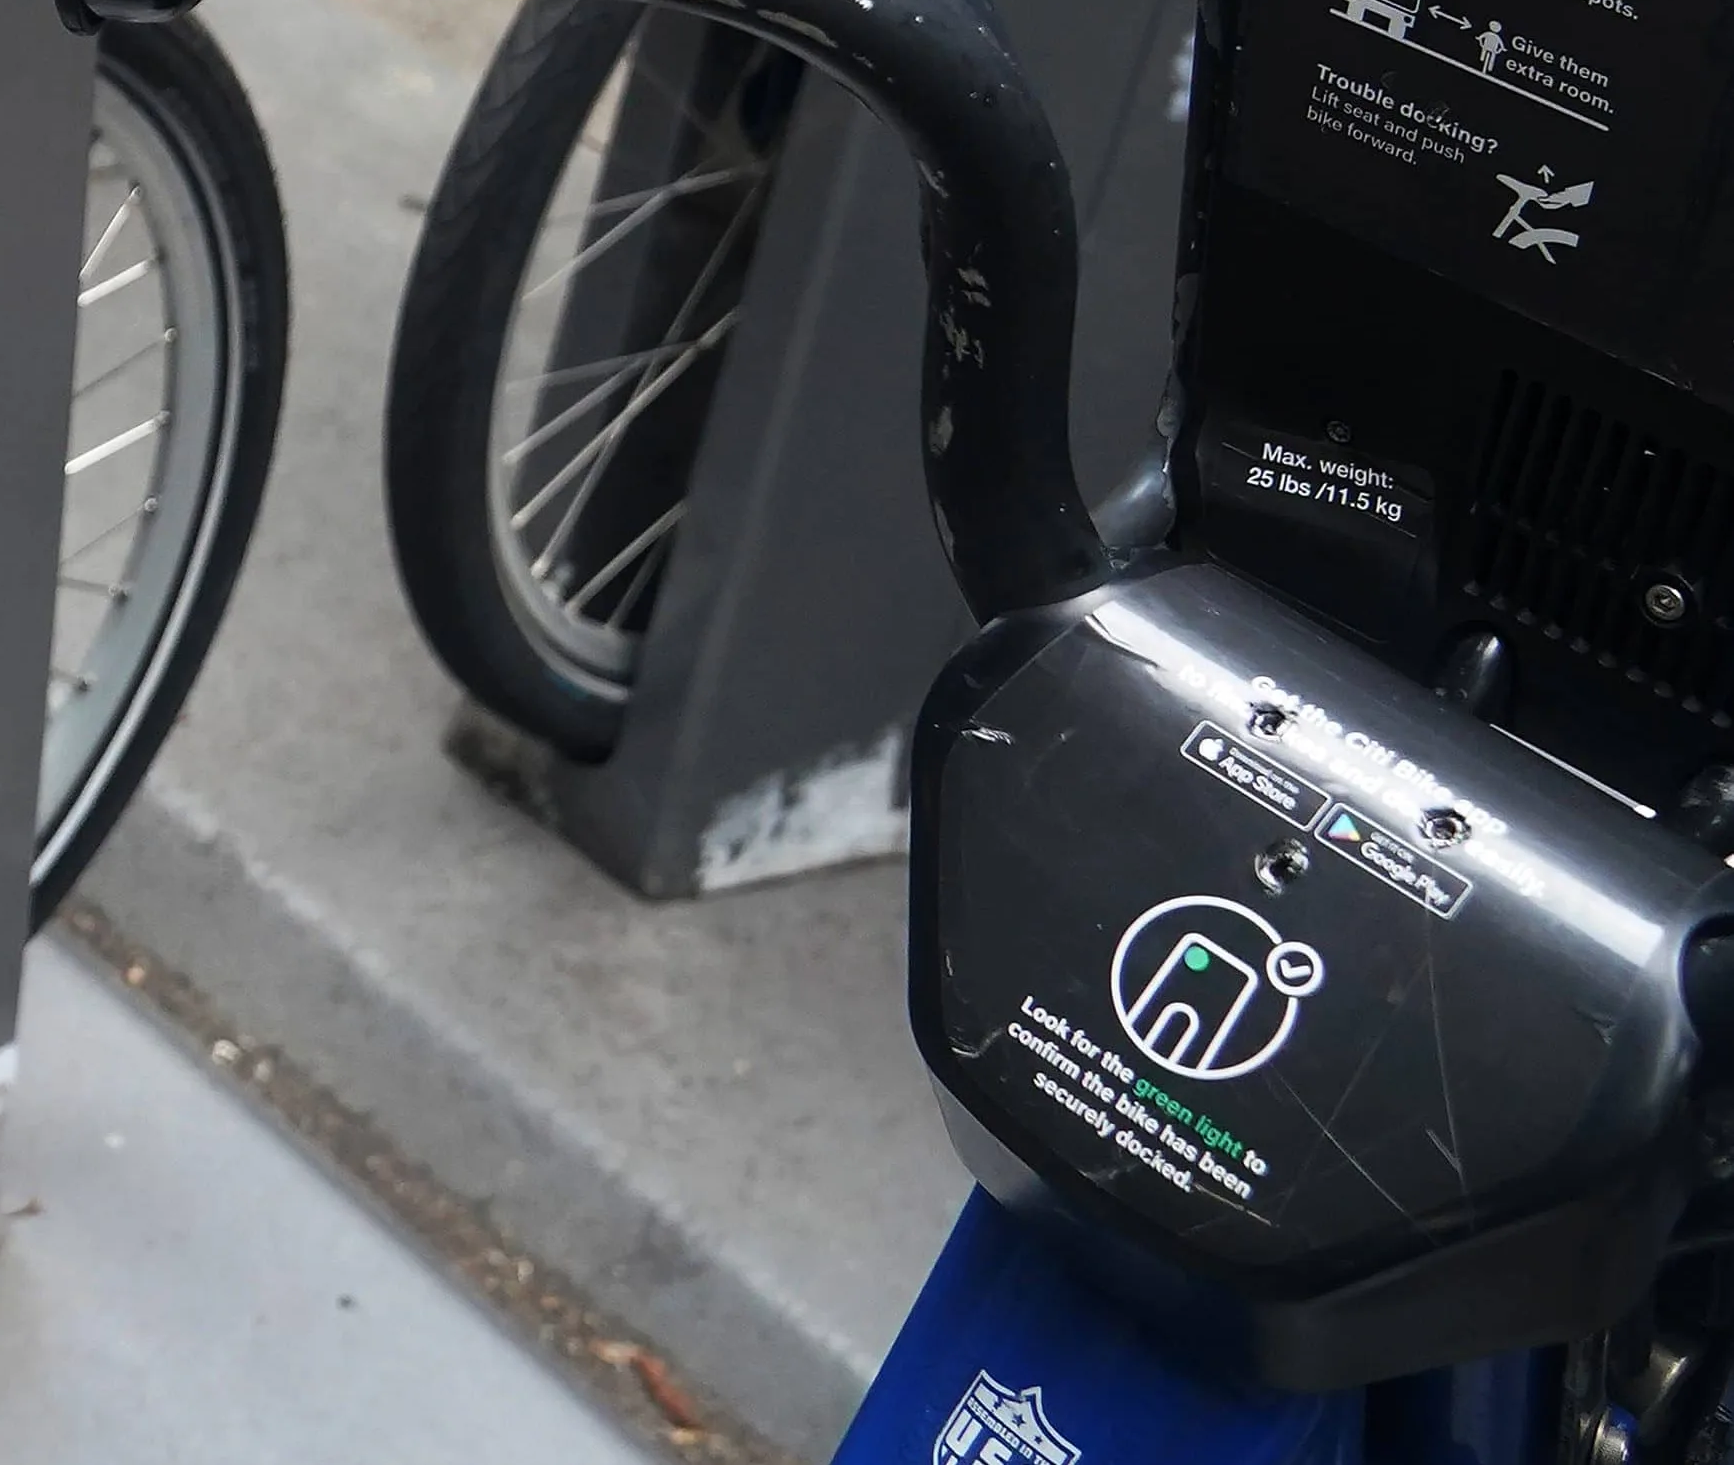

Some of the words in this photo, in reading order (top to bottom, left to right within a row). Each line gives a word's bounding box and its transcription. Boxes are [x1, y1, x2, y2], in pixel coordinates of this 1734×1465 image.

[1505, 58, 1554, 88] extra
[1559, 81, 1615, 114] room.
[1511, 35, 1554, 64] Give
[1559, 55, 1609, 88] them
[1307, 105, 1342, 132] bike
[1347, 123, 1417, 165] forward.
[1311, 86, 1340, 110] Lift
[1343, 100, 1381, 127] seat
[1384, 117, 1417, 142] and
[1420, 134, 1466, 164] push
[1317, 64, 1395, 109] Trouble
[1400, 102, 1499, 155] docking?
[1246, 467, 1275, 486] 25
[1279, 474, 1311, 497] lbs
[1314, 483, 1370, 510] /11.5
[1375, 496, 1402, 522] kg
[1262, 442, 1312, 470] Max.
[1319, 459, 1394, 489] weight:
[1179, 664, 1207, 687] to
[1329, 758, 1382, 795] and
[1251, 676, 1301, 712] Get
[1299, 703, 1343, 736] the
[1345, 731, 1397, 767] Citi
[1393, 759, 1453, 802] Bike
[1453, 799, 1509, 837] app
[1219, 756, 1254, 785] App
[1253, 775, 1296, 811] Store
[1361, 841, 1417, 885] Google
[1416, 874, 1451, 906] Play
[1007, 1022, 1081, 1080] confirm
[1082, 1071, 1115, 1103] the
[1115, 1092, 1159, 1135] bike
[1159, 1123, 1199, 1163] has
[1198, 1150, 1253, 1200] been
[1020, 995, 1070, 1040] Look
[1070, 1030, 1103, 1059] for
[1100, 1051, 1134, 1084] the
[1133, 1078, 1194, 1125] green
[1194, 1114, 1244, 1160] light
[1243, 1149, 1268, 1176] to
[1033, 1071, 1116, 1138] securely
[1115, 1129, 1193, 1193] docked.
